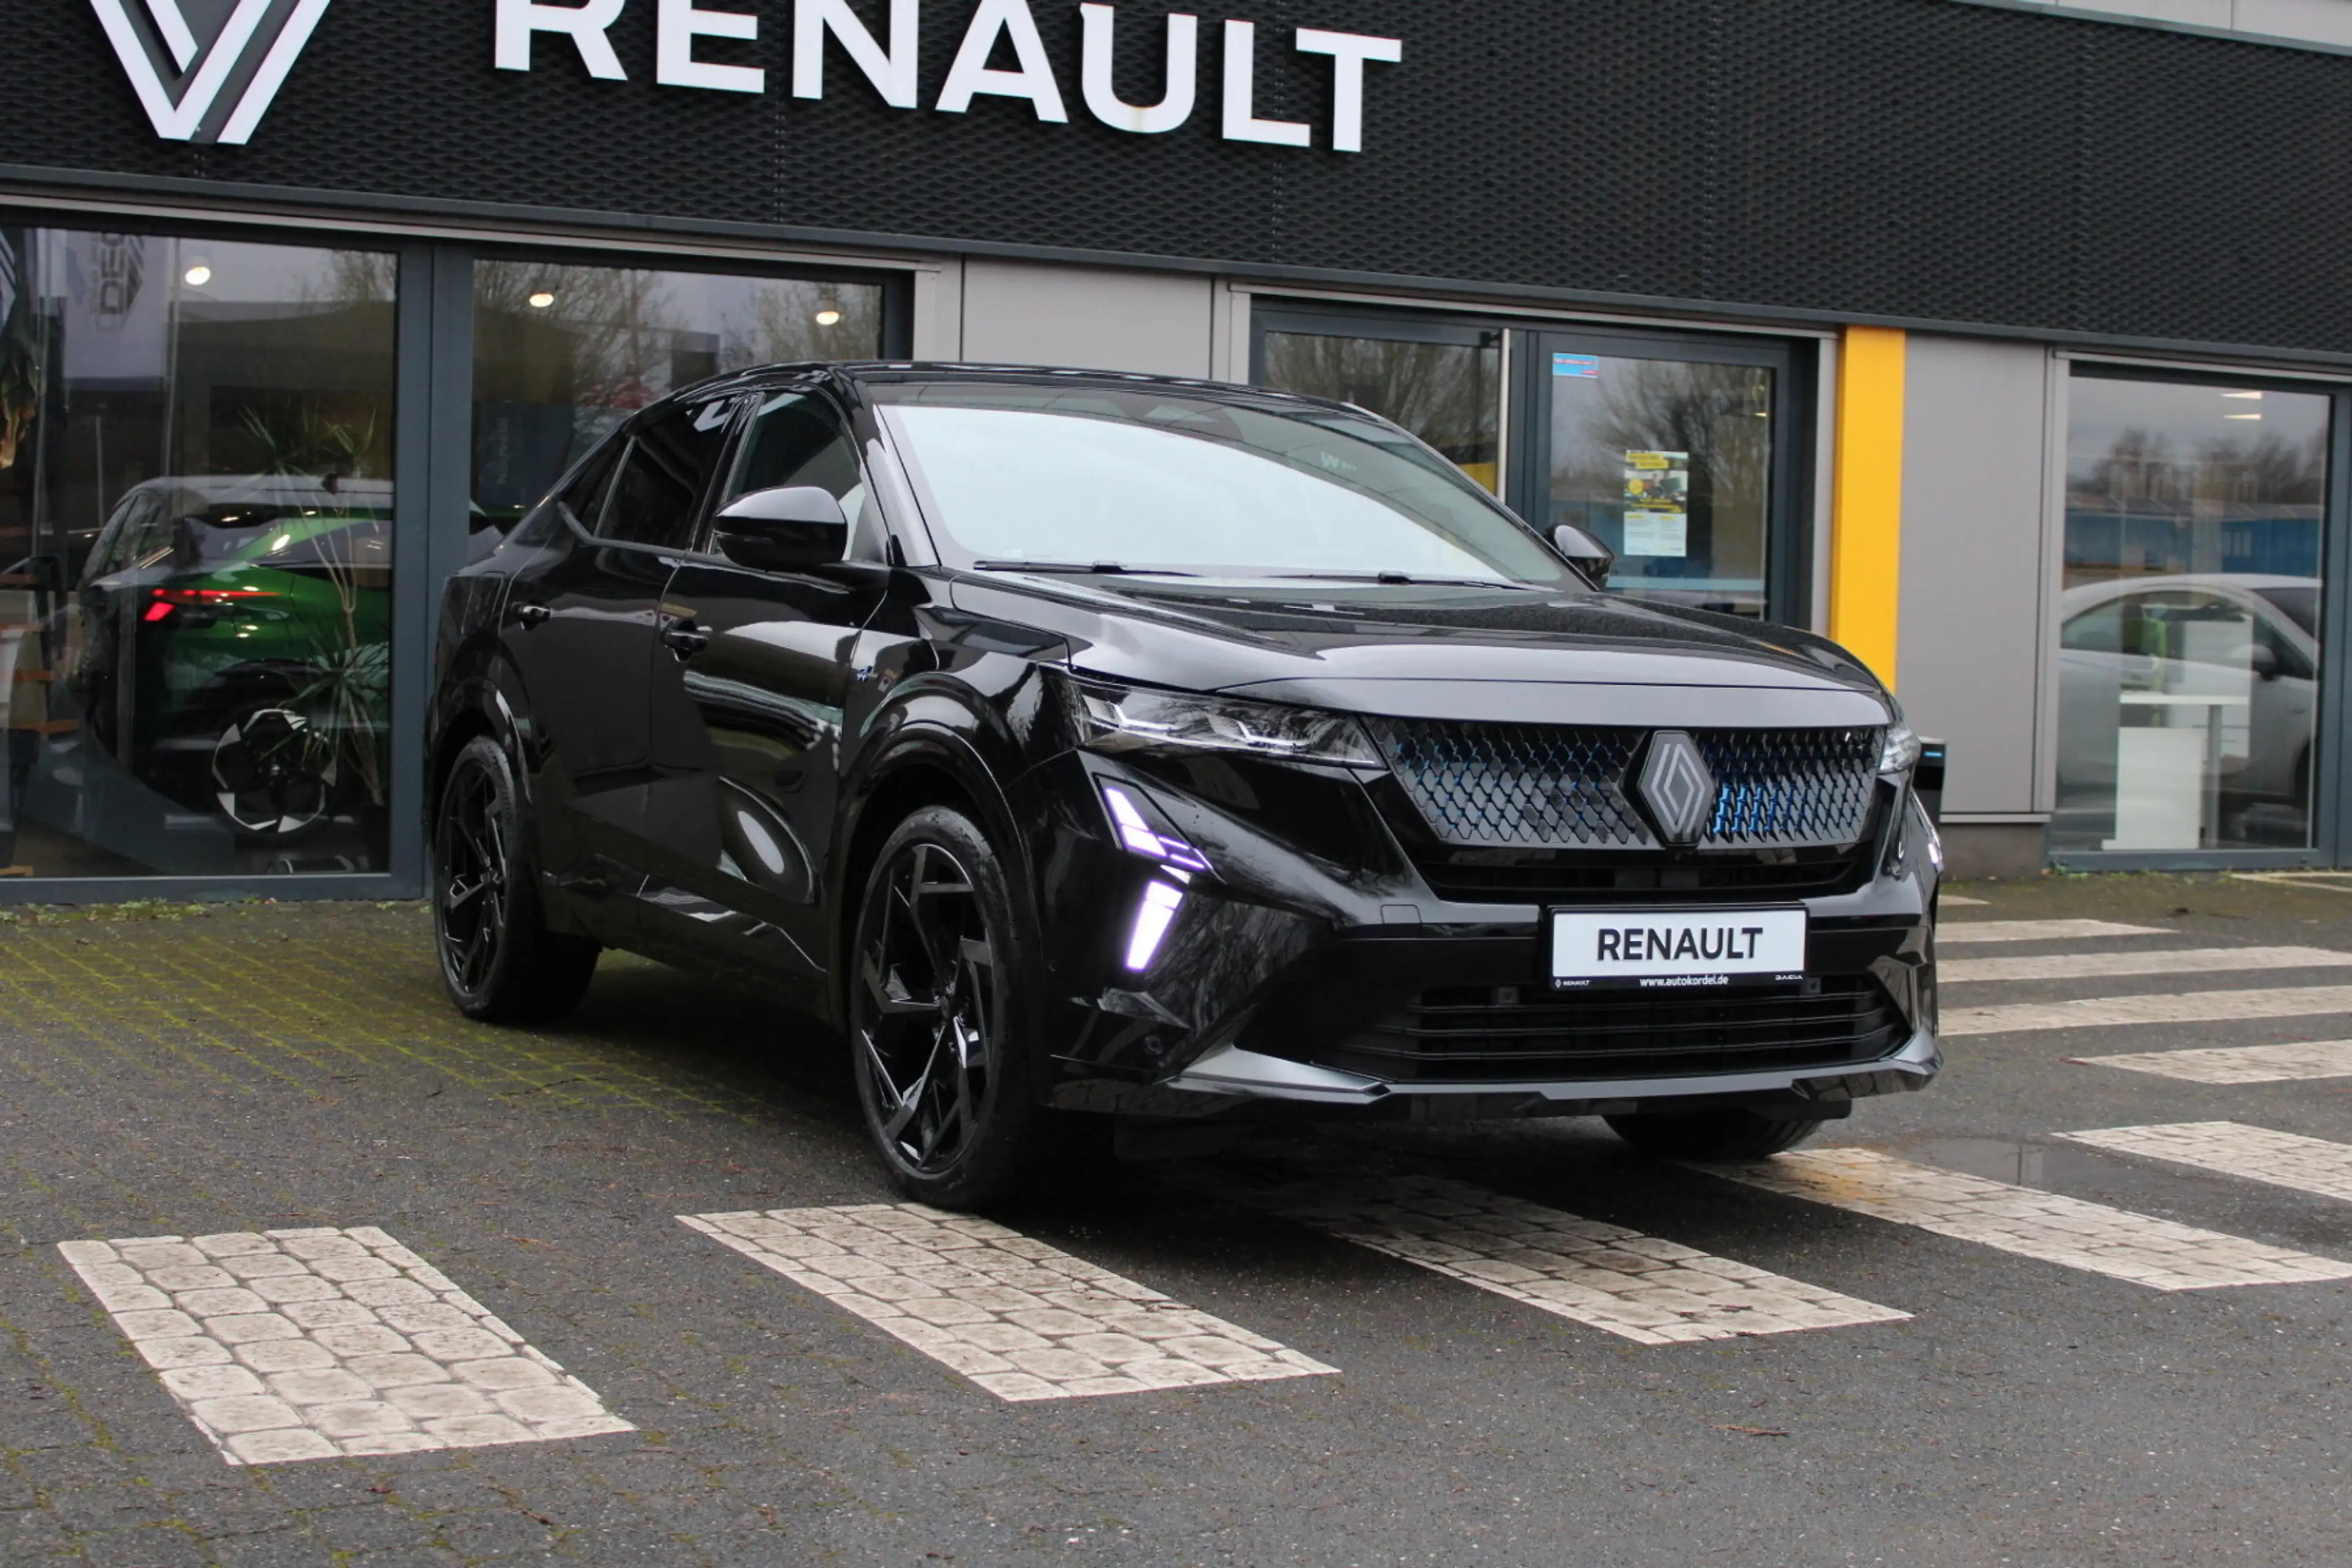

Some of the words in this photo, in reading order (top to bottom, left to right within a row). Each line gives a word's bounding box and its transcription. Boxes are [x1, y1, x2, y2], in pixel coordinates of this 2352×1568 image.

[494, 0, 1402, 152] RENAULT
[1597, 927, 1763, 960] RENAULT
[1640, 975, 1728, 987] www.autokordel.de
